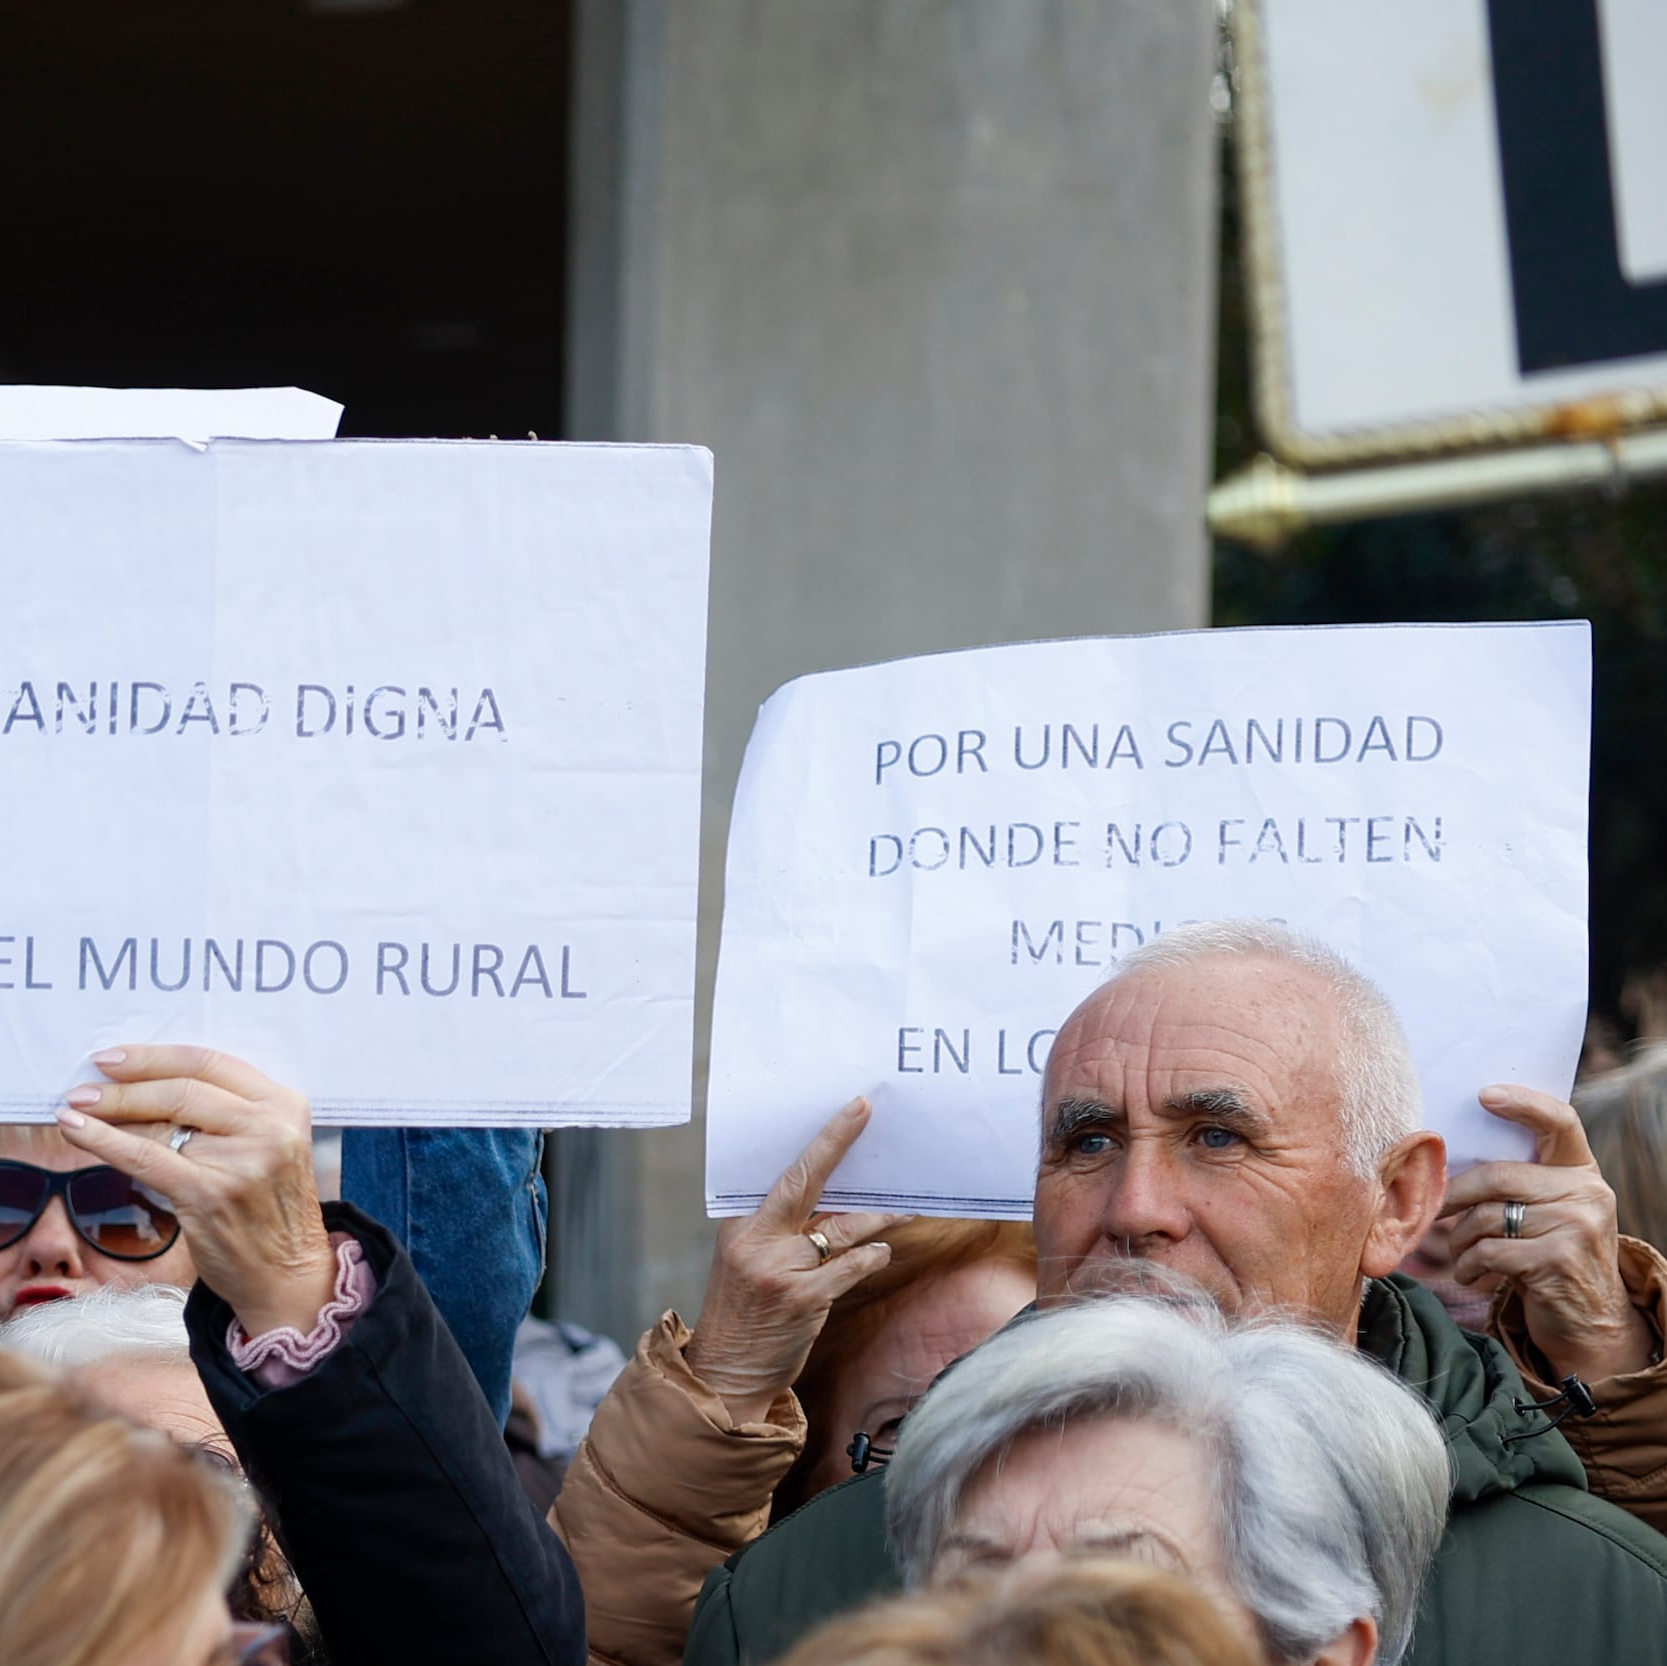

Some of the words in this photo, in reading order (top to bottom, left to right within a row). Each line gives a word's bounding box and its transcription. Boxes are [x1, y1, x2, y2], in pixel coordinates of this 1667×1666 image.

[876, 728, 988, 786] POR
[1013, 722, 1144, 771] UNA
[1165, 715, 1445, 768] SANIDAD
[869, 820, 1080, 878] DONDE
[1106, 820, 1194, 868] NO
[1218, 815, 1445, 866] FALTEN
[77, 935, 350, 995] MUNDO
[376, 941, 588, 1000] RURAL
[897, 1026, 971, 1075] EN
